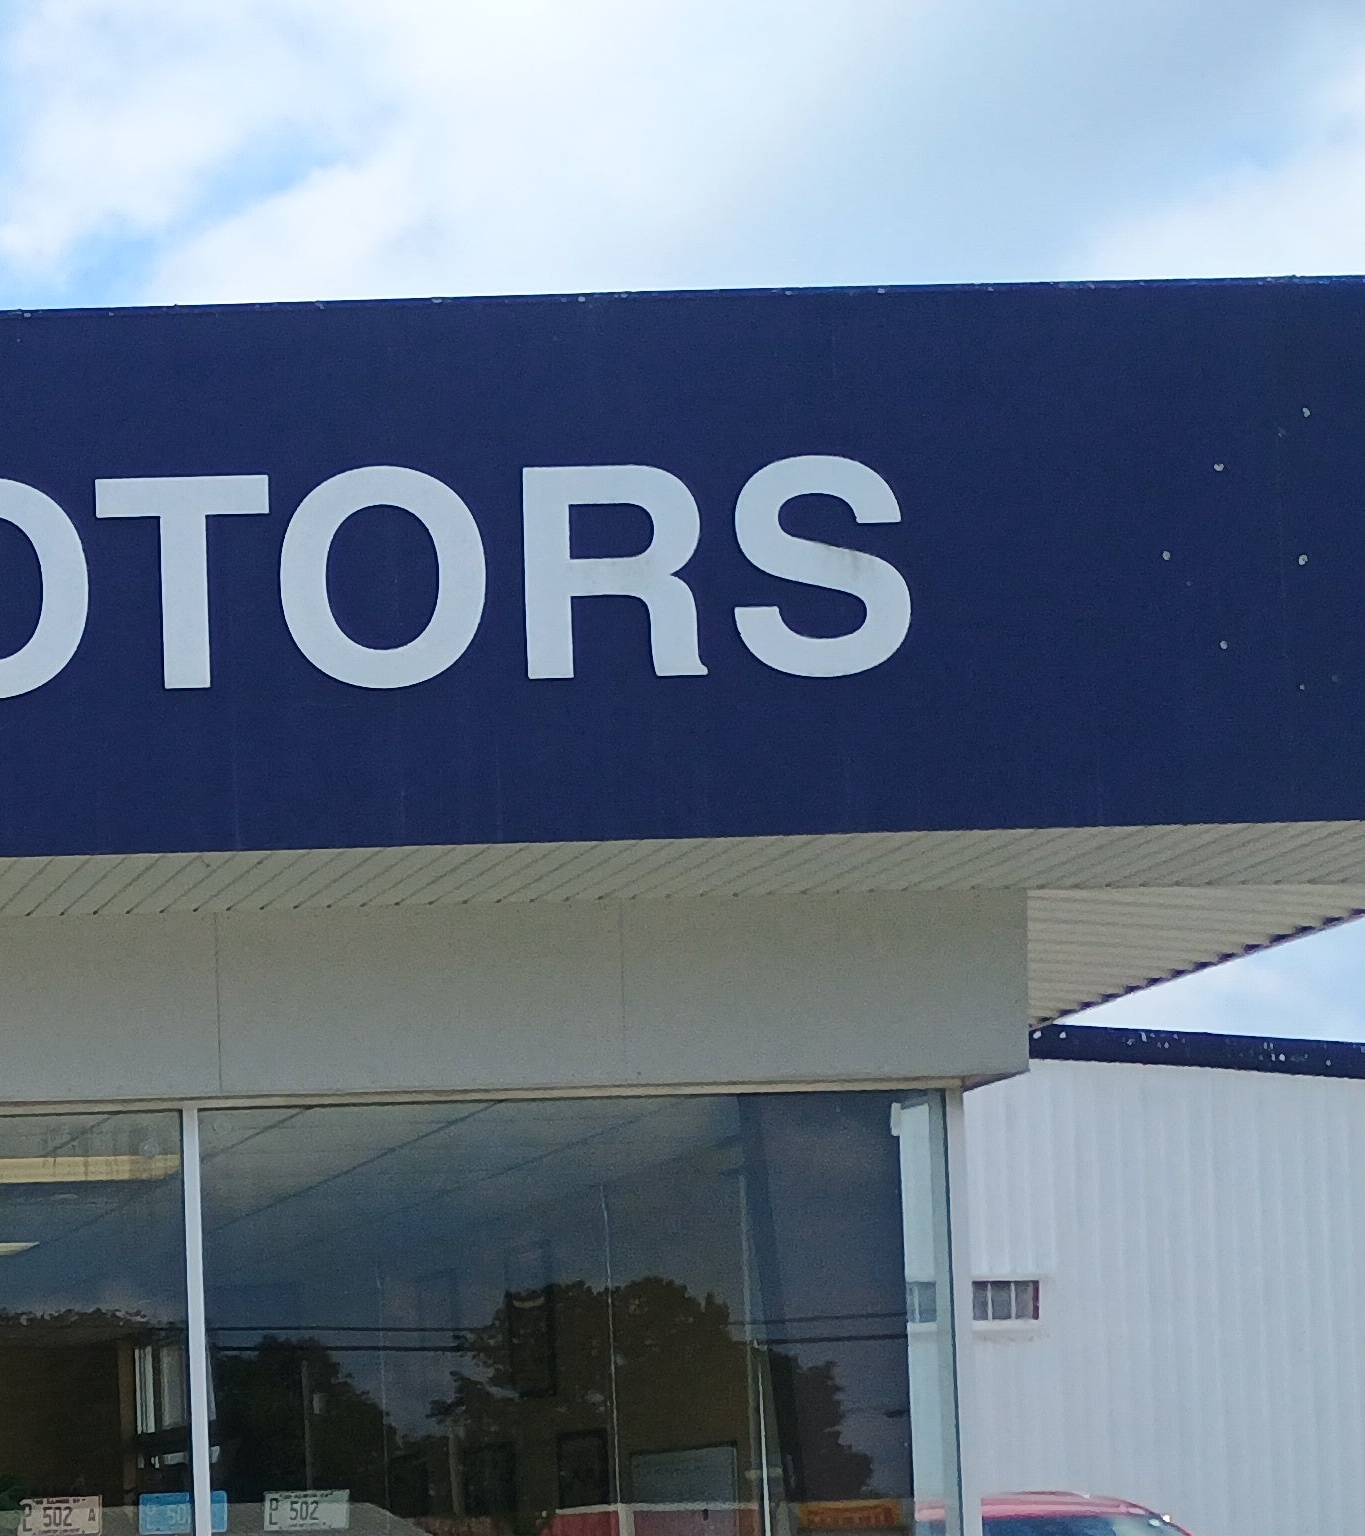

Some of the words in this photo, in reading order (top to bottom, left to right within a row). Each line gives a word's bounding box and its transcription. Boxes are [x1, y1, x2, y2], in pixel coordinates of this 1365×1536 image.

[42, 1506, 73, 1528] 502
[87, 1507, 96, 1522] A
[289, 1500, 320, 1521] 502
